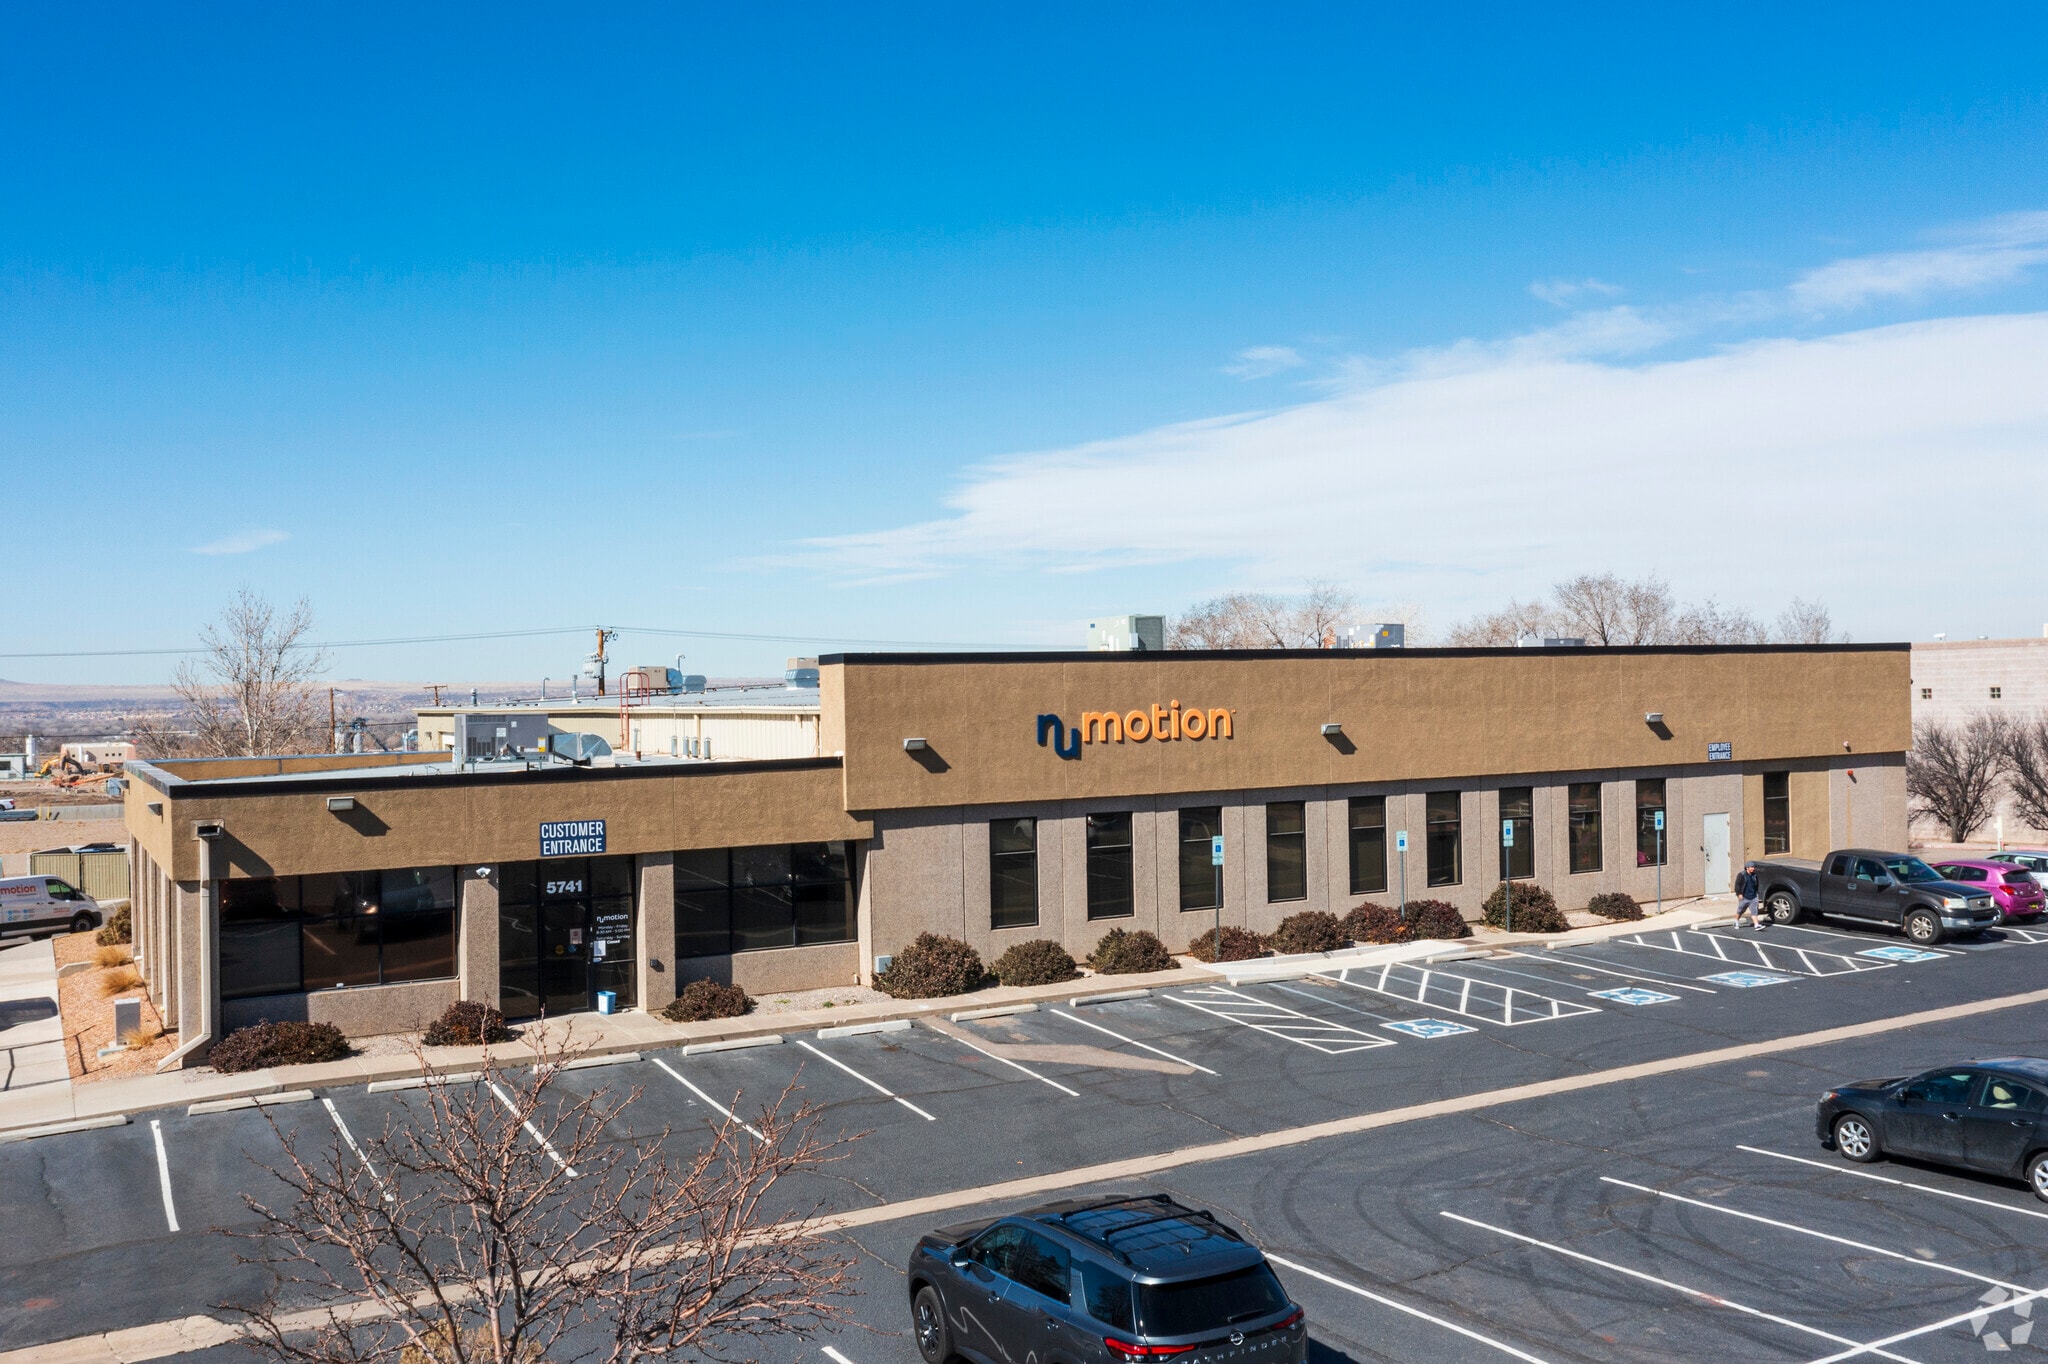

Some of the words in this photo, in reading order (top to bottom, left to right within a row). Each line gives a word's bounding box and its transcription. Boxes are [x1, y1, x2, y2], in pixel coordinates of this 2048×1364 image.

[1037, 700, 1233, 761] numotion
[1709, 743, 1731, 751] EMPLOYEE
[1709, 752, 1731, 760] ENTRANCE
[541, 821, 604, 838] CUSTOMER
[543, 838, 602, 855] ENTRANCE
[546, 880, 583, 894] 5741
[596, 914, 629, 923] numotion
